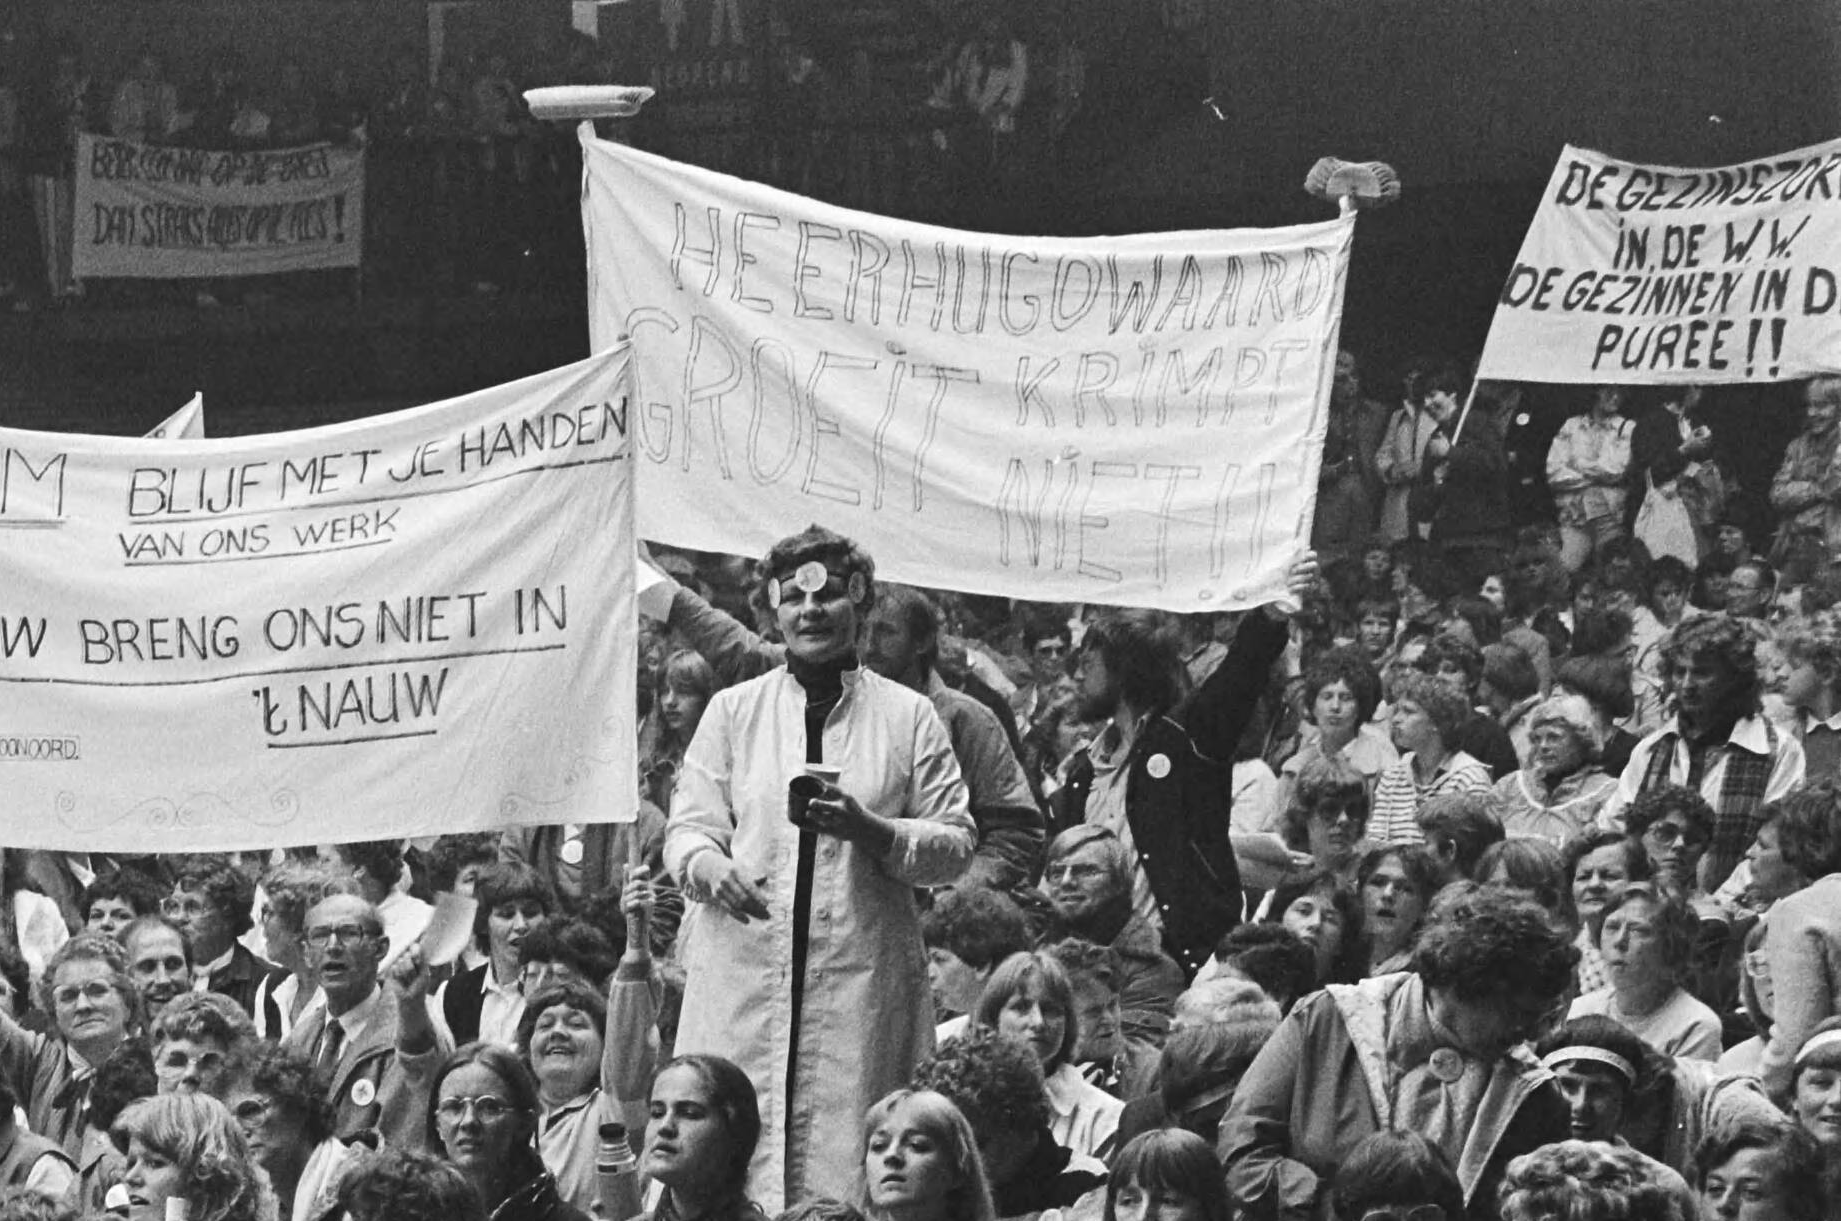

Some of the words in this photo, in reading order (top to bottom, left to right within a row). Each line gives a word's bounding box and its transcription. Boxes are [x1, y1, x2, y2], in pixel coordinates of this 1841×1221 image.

[1556, 161, 1619, 210] DE
[670, 202, 1331, 336] HEERHUGOWAARD
[1661, 224, 1707, 269] DE
[1499, 263, 1564, 312] DE
[1562, 270, 1745, 316] GEZINNEN
[1749, 266, 1791, 313] IN
[626, 306, 981, 512] GROEIT
[1015, 339, 1309, 428] KRIMPT
[128, 461, 267, 518] BLIJF
[280, 449, 383, 500] MET
[388, 440, 445, 483] JE
[459, 396, 629, 473] HANDEN
[119, 531, 184, 561] VAN
[198, 524, 270, 557] ONS
[293, 506, 401, 547] WERK
[79, 615, 240, 665] BRENG
[263, 602, 365, 652] ONS
[376, 591, 487, 645] NIET
[514, 584, 567, 636] IN
[298, 667, 449, 733] NAUW
